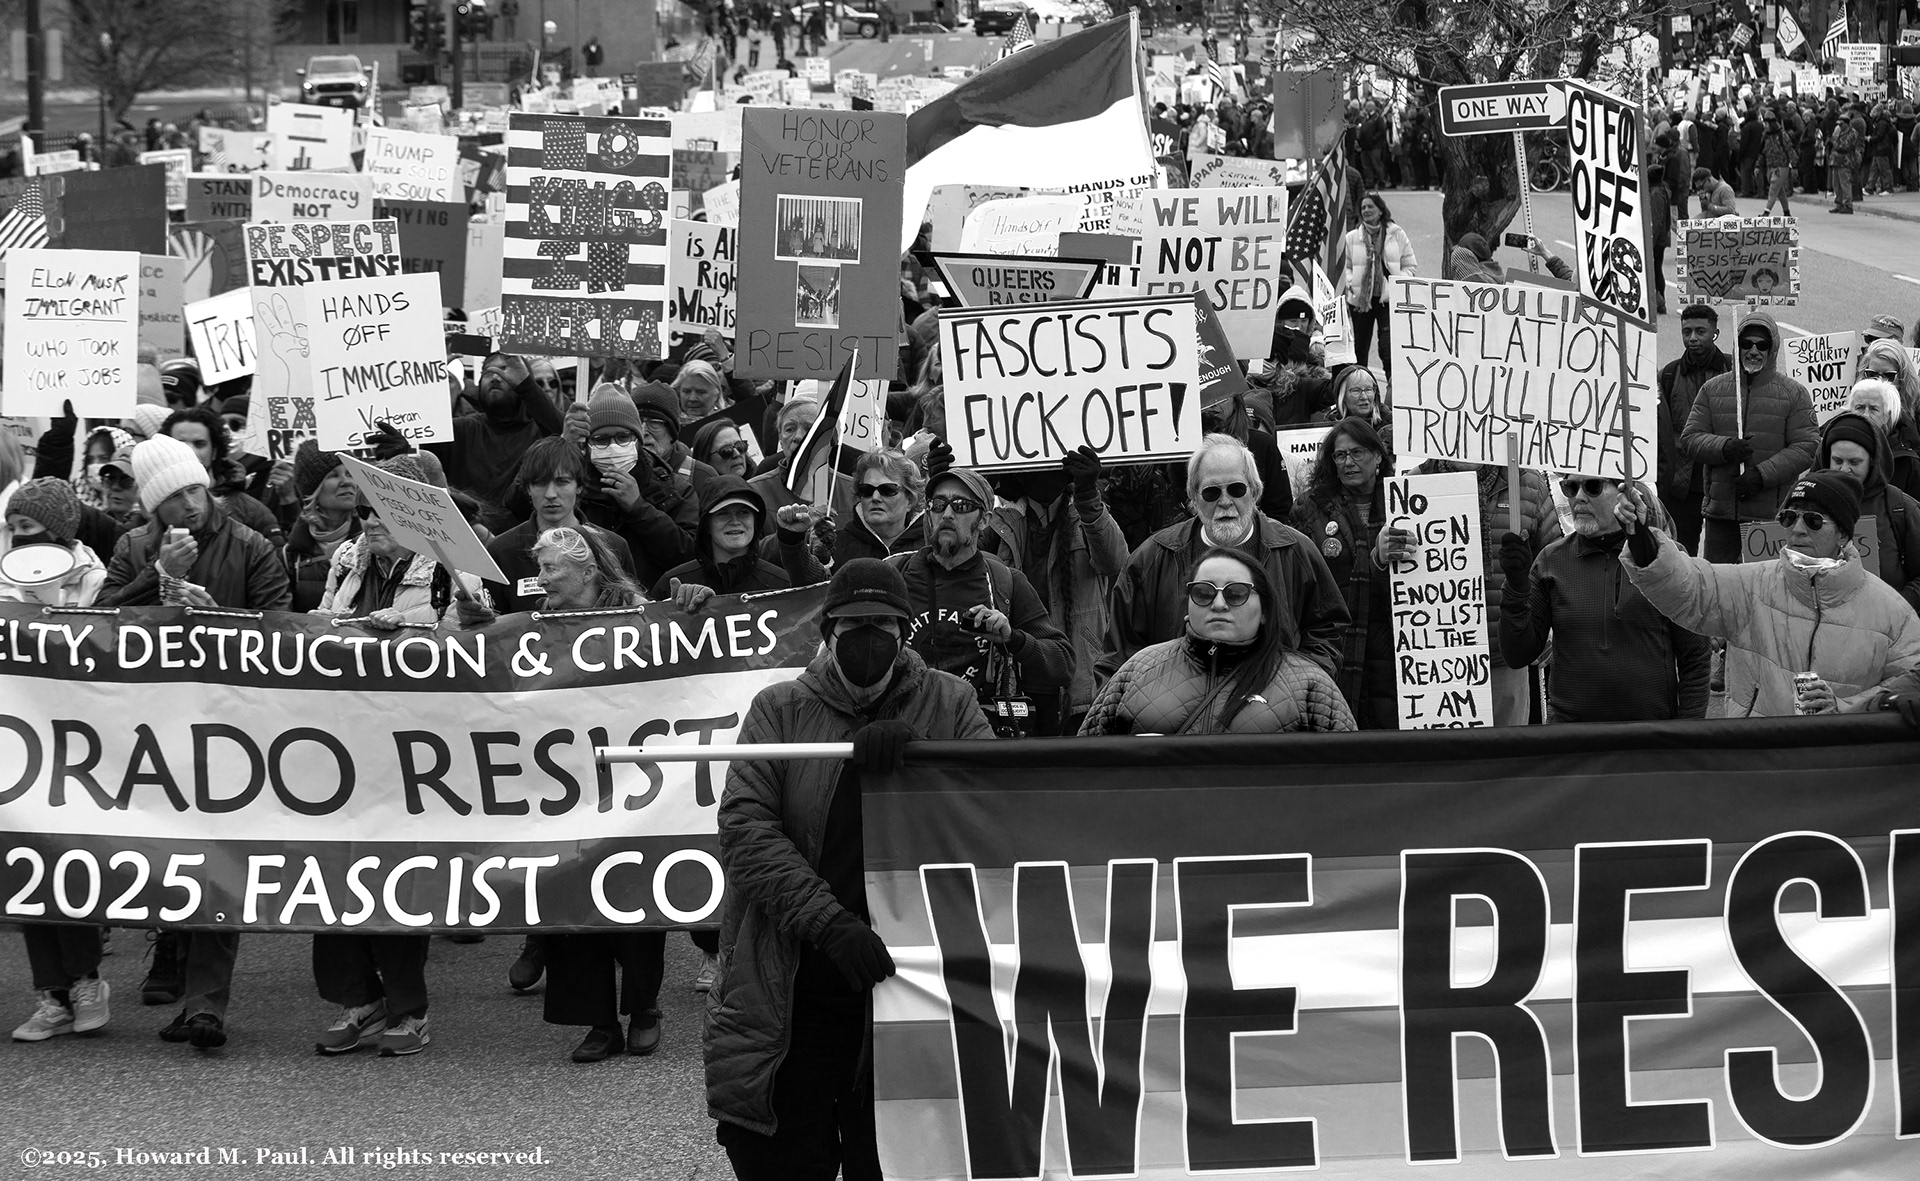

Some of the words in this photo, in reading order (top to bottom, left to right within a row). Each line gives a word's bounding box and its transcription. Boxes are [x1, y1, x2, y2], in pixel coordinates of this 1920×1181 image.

[1458, 99, 1498, 118] ONE
[1506, 96, 1549, 114] WAY
[783, 114, 876, 144] HONOR
[371, 134, 434, 163] TRUMP
[542, 120, 639, 170] NO
[806, 140, 852, 160] OUR
[408, 165, 448, 182] SOLD
[761, 152, 889, 183] VETERANS
[259, 175, 360, 208] Democracy
[396, 182, 446, 201] SOULS
[1069, 179, 1125, 194] HANDS
[1572, 159, 1638, 236] OFF
[211, 202, 252, 217] WITH
[293, 203, 331, 218] NOT
[528, 176, 665, 237] KINGS
[1152, 198, 1200, 226] WE
[1217, 195, 1281, 226] WILL
[247, 220, 397, 259] RESPECT
[993, 216, 1029, 236] Hands
[1686, 229, 1791, 251] PERSISTENCE
[686, 232, 705, 258] is
[1158, 236, 1222, 274] NOT
[1231, 235, 1273, 272] BE
[1728, 247, 1742, 257] IS
[531, 241, 630, 294] IN
[972, 267, 1056, 291] QUEERS
[22, 298, 127, 317] IMMIGRANT
[322, 292, 410, 323] HANDS
[1395, 279, 1454, 310] IF
[1462, 285, 1526, 316] YOU
[500, 300, 660, 355] AMERICA
[26, 340, 68, 357] WHO
[77, 338, 120, 357] TOOK
[748, 329, 893, 373] RESIST
[951, 308, 1178, 382] FASCISTS
[1394, 310, 1643, 381] INFLATION
[1788, 335, 1833, 354] SOCIAL
[1797, 347, 1850, 364] SECURITY
[23, 368, 69, 391] YOUR
[78, 368, 122, 386] JOBS
[320, 360, 448, 401] IMMIGRANTS
[1198, 364, 1232, 383] ENOUGH
[1792, 367, 1802, 377] IS
[1808, 361, 1846, 383] NOT
[1406, 356, 1535, 422] YOU'LL
[1548, 372, 1651, 437] LOVE
[357, 404, 422, 430] Veteran
[964, 391, 1070, 466] FUCK
[1081, 382, 1188, 454] OFF!
[1393, 405, 1511, 463] TRUMP
[1511, 419, 1650, 481] TARIFFS
[361, 469, 395, 493] NOW
[390, 511, 457, 546] GRANDMA
[418, 508, 444, 526] OFF
[1424, 547, 1467, 573] BIG
[1393, 575, 1483, 605] ENOUGH
[1394, 610, 1431, 628] TO
[1437, 603, 1485, 626] LIST
[117, 623, 488, 680] DESTRUCTION
[511, 631, 553, 678] &
[572, 609, 779, 674] CRIMES
[1396, 628, 1436, 653] ALL
[1435, 628, 1479, 648] THE
[1400, 653, 1490, 686] REASONS
[1403, 694, 1425, 719] I
[1437, 689, 1477, 718] AM
[392, 711, 740, 818] RESIST
[4, 846, 206, 923] 2025
[242, 853, 560, 927] FASCIST
[590, 848, 725, 925] CO
[917, 855, 1322, 1181] WE
